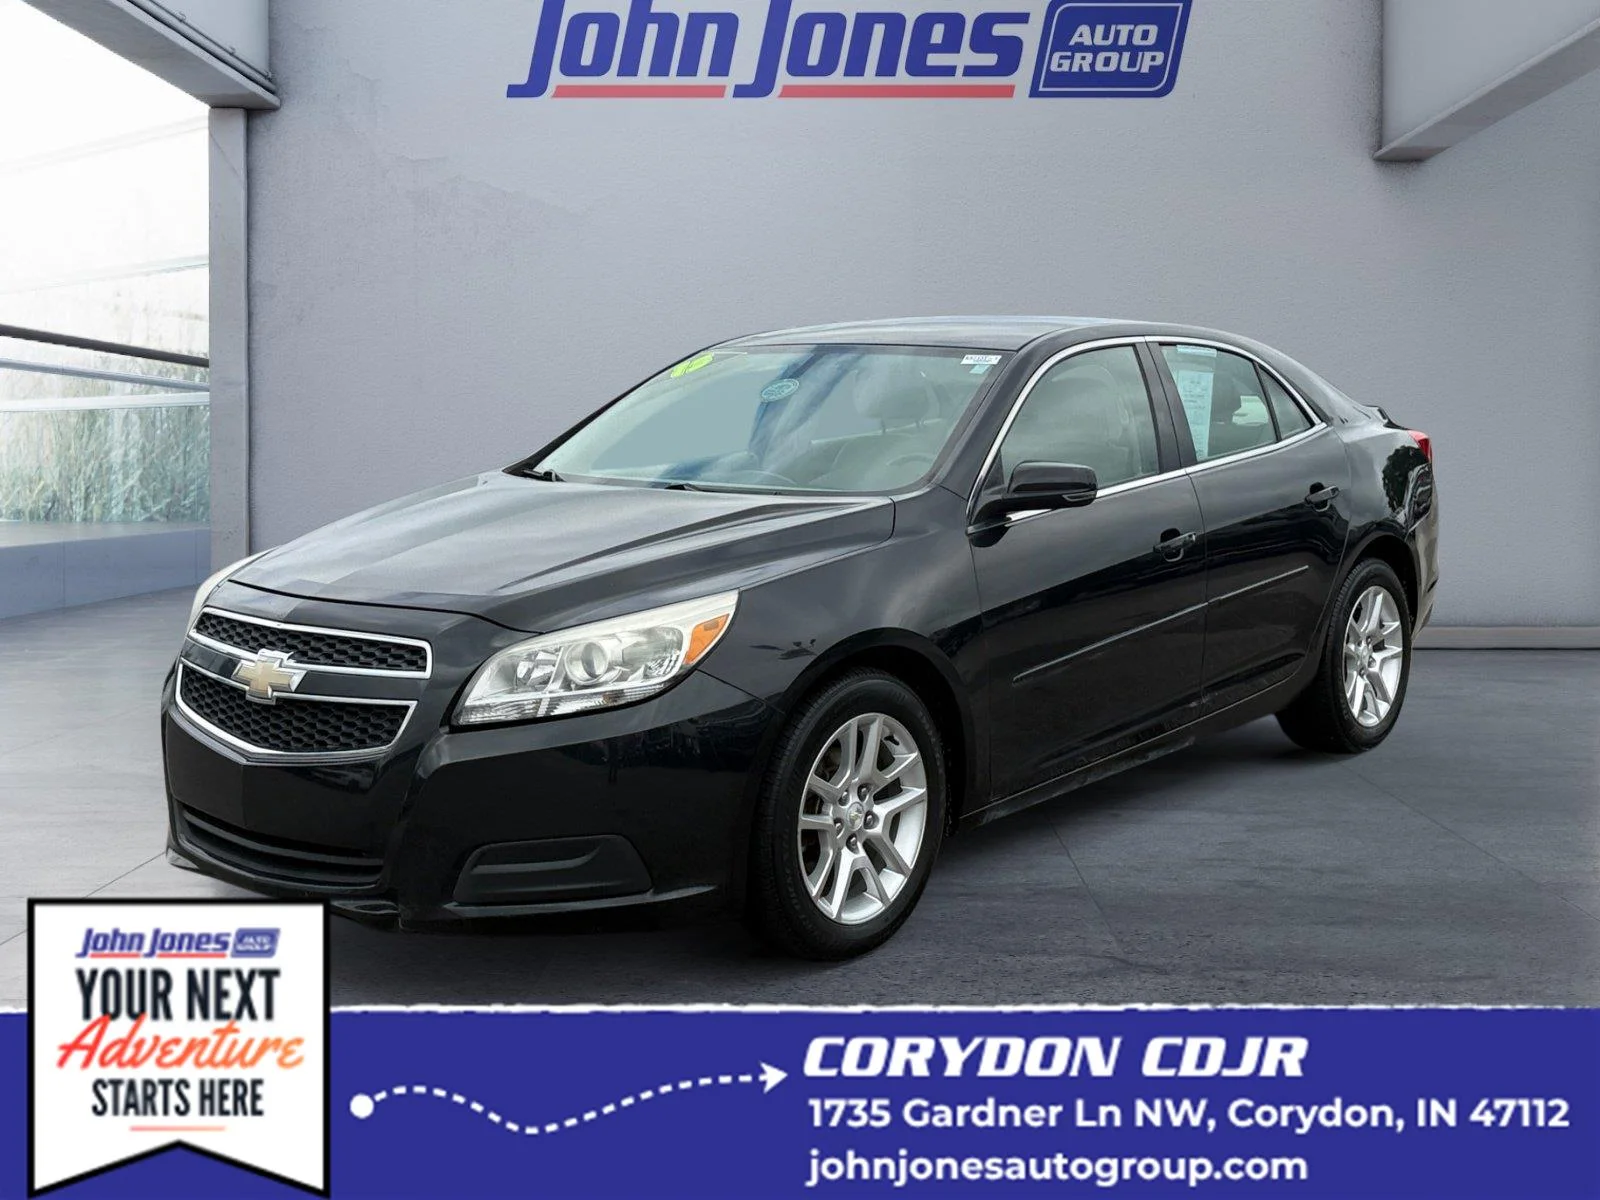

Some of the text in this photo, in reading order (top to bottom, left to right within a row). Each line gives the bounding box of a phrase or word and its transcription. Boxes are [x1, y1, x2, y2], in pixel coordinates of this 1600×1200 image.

[1068, 24, 1159, 46] AUTO
[507, 0, 1030, 98] John Jones
[1050, 51, 1165, 73] GROUP
